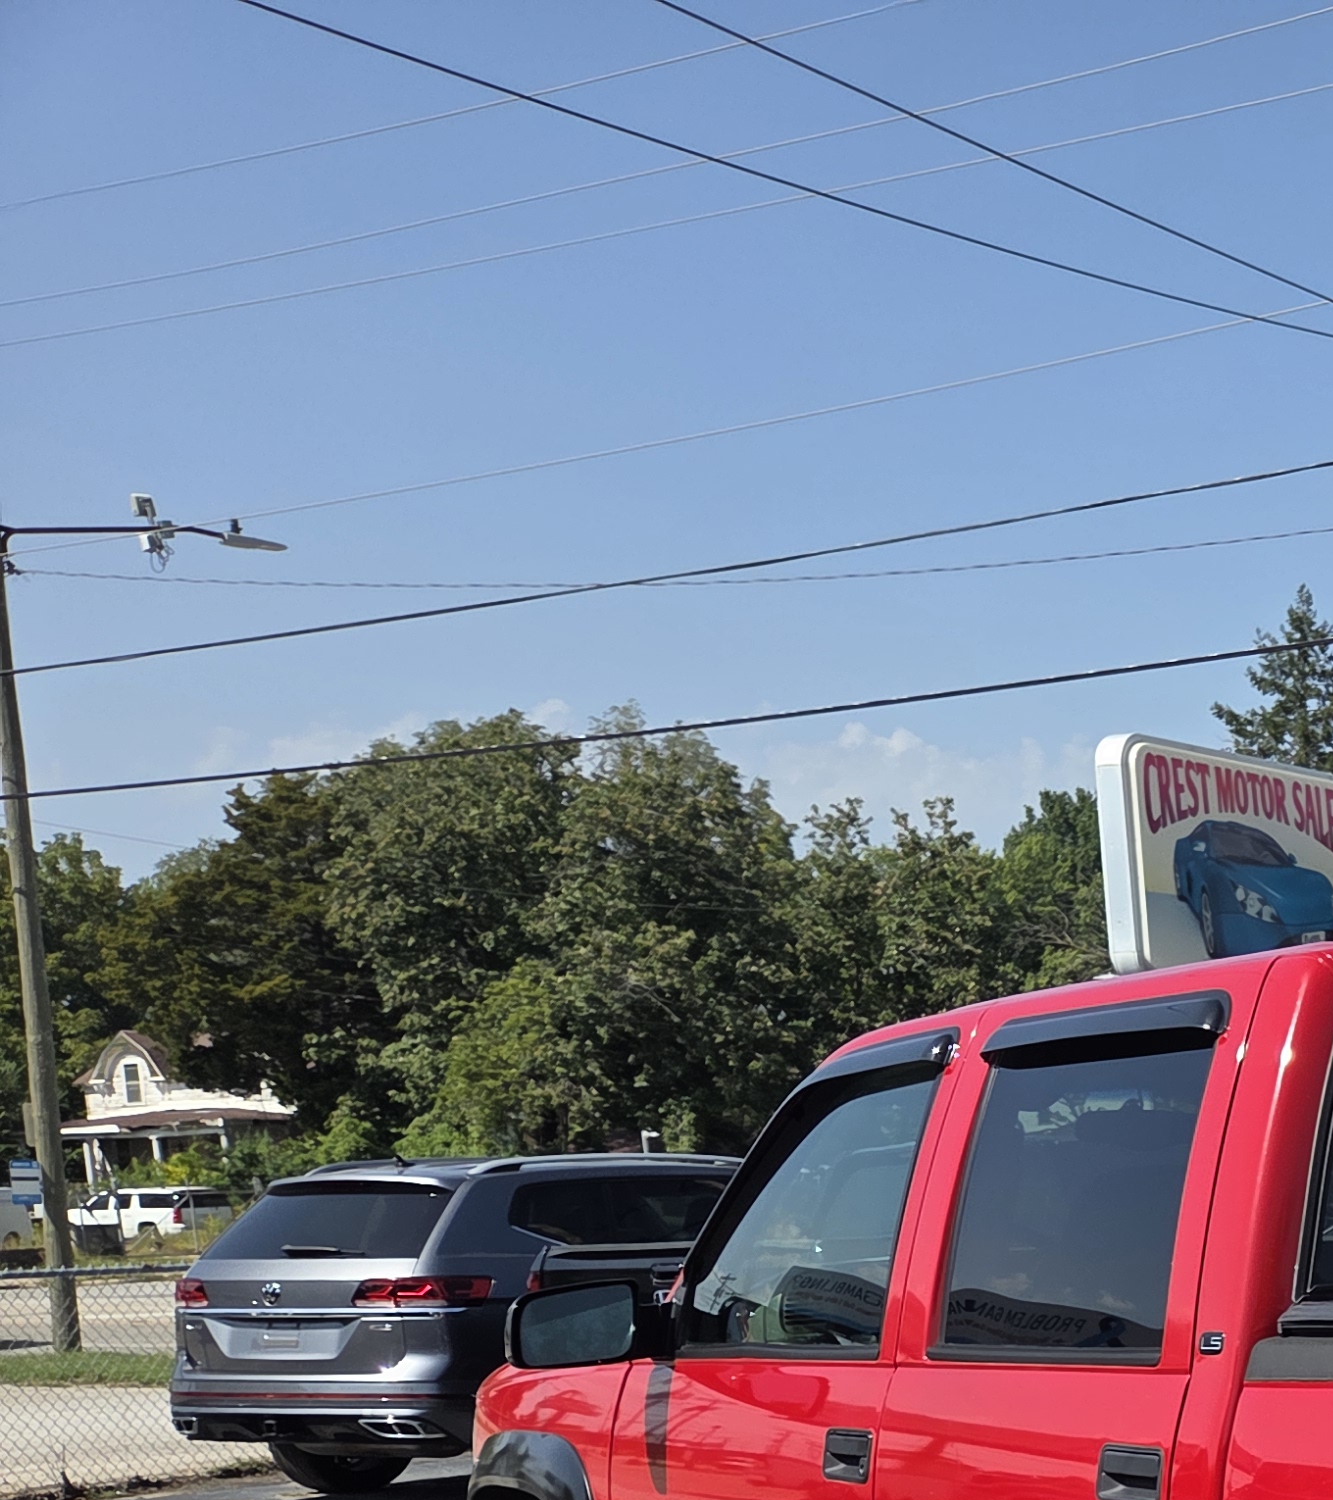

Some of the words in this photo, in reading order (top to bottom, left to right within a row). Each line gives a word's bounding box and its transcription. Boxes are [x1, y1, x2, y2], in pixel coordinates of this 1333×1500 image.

[1143, 752, 1210, 834] CREST
[1214, 766, 1291, 826] MOTOR
[1200, 1336, 1223, 1350] LS
